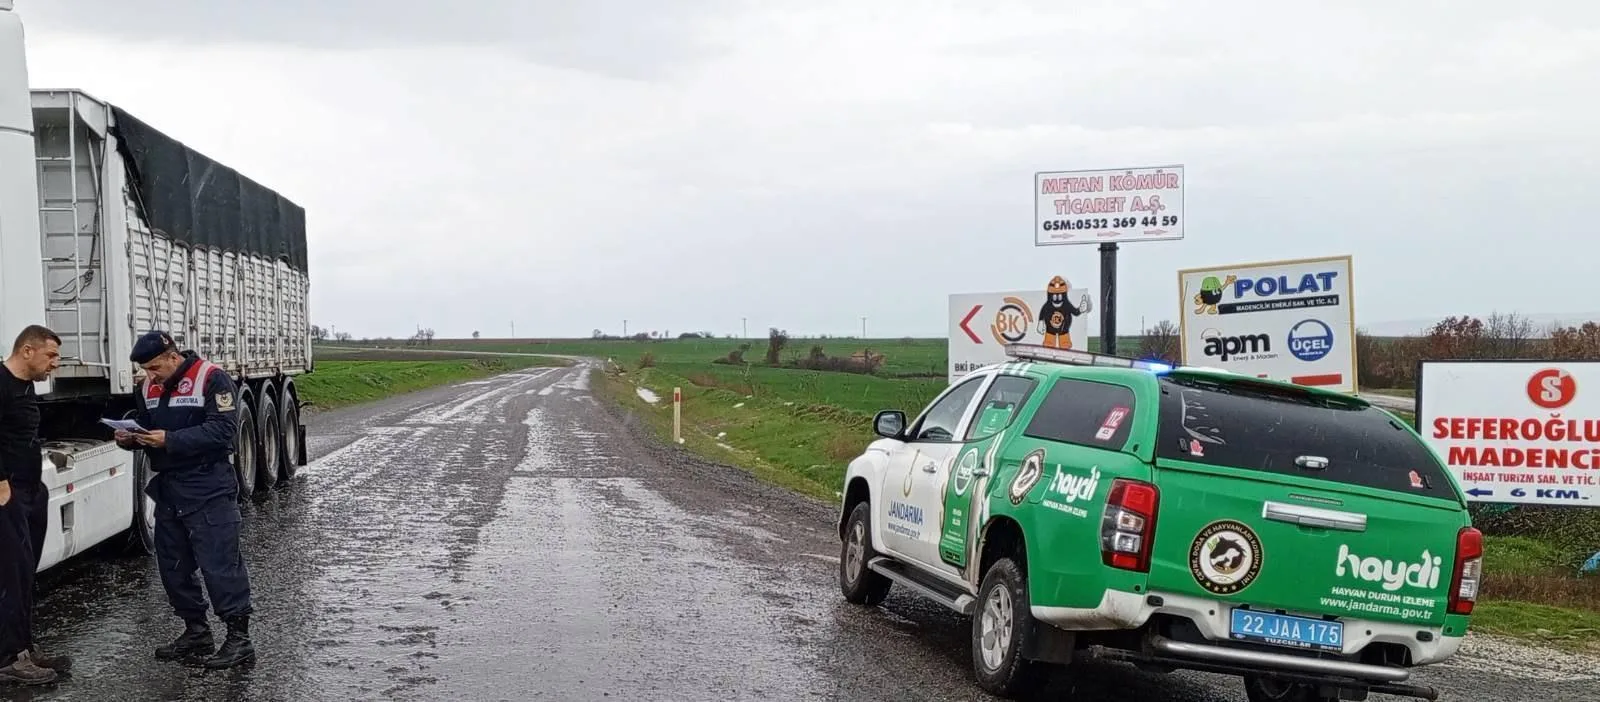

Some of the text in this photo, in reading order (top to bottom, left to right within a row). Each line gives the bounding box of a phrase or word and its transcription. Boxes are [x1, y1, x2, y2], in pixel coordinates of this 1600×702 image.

[1042, 170, 1179, 194] METAN KÖMÜR
[1054, 195, 1165, 216] TİCARET A.Ş.
[1043, 215, 1178, 231] GSM:0532 369 44 59
[1234, 271, 1338, 299] POLAT
[1204, 333, 1270, 362] apm
[1292, 338, 1329, 352] ÜÇEL
[1433, 413, 1600, 442] SEFEROĞLU
[1049, 463, 1101, 503] haydi
[1463, 470, 1596, 486] İNŞAAT TURİZM SAN. VE TİC.
[1510, 488, 1527, 498] 6
[888, 500, 924, 526] JANDARMA
[1336, 544, 1442, 591] haydi
[1331, 586, 1367, 599] HAYVAN
[1367, 591, 1401, 603] DURUM
[1320, 597, 1433, 620] www.jandarma.gov.tr
[1243, 615, 1339, 644] 22 JAA 175
